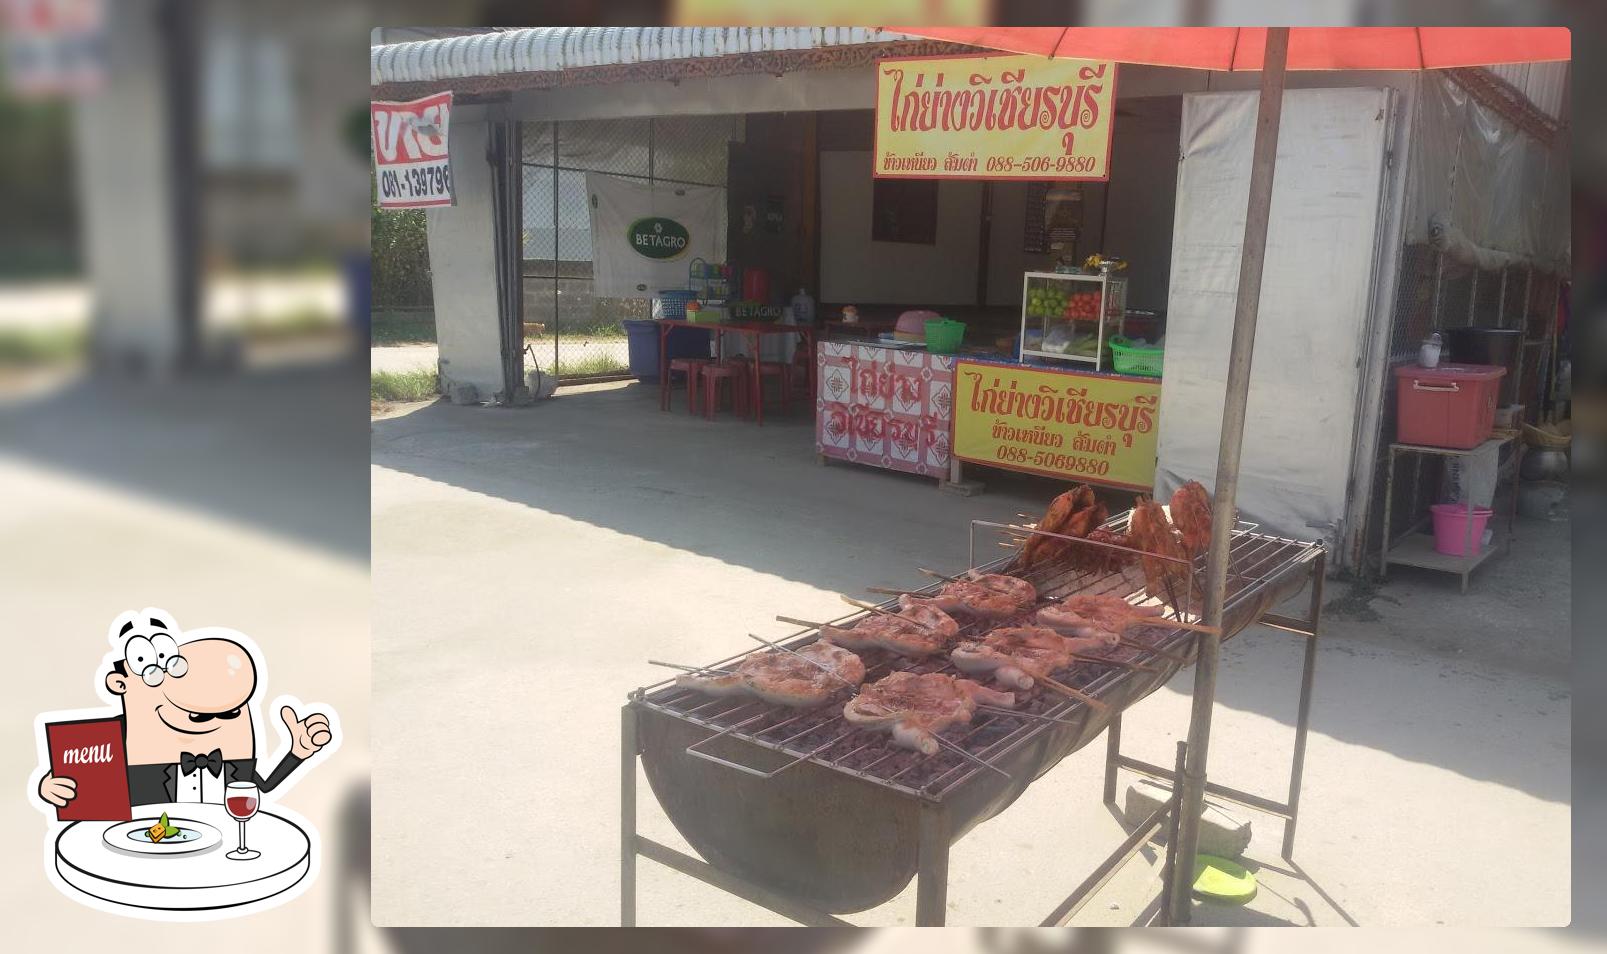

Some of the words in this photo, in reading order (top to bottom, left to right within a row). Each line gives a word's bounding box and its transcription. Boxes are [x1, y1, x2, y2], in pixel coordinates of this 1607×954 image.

[883, 63, 1107, 156] ไก่ย่างวิเชียรบุรี
[374, 103, 449, 162] ขาย
[883, 151, 937, 172] ข้าวเหนียว
[943, 151, 978, 172] ส้มตำ
[986, 155, 1096, 173] 088-506-9880
[635, 233, 686, 249] BETAGRO
[964, 371, 1159, 448] ไก่ย่างวิเชียรบุรี
[992, 418, 1064, 448] ข้าวเหนียว
[1073, 430, 1117, 456] ส้มตำ
[996, 445, 1110, 476] 088-5069880
